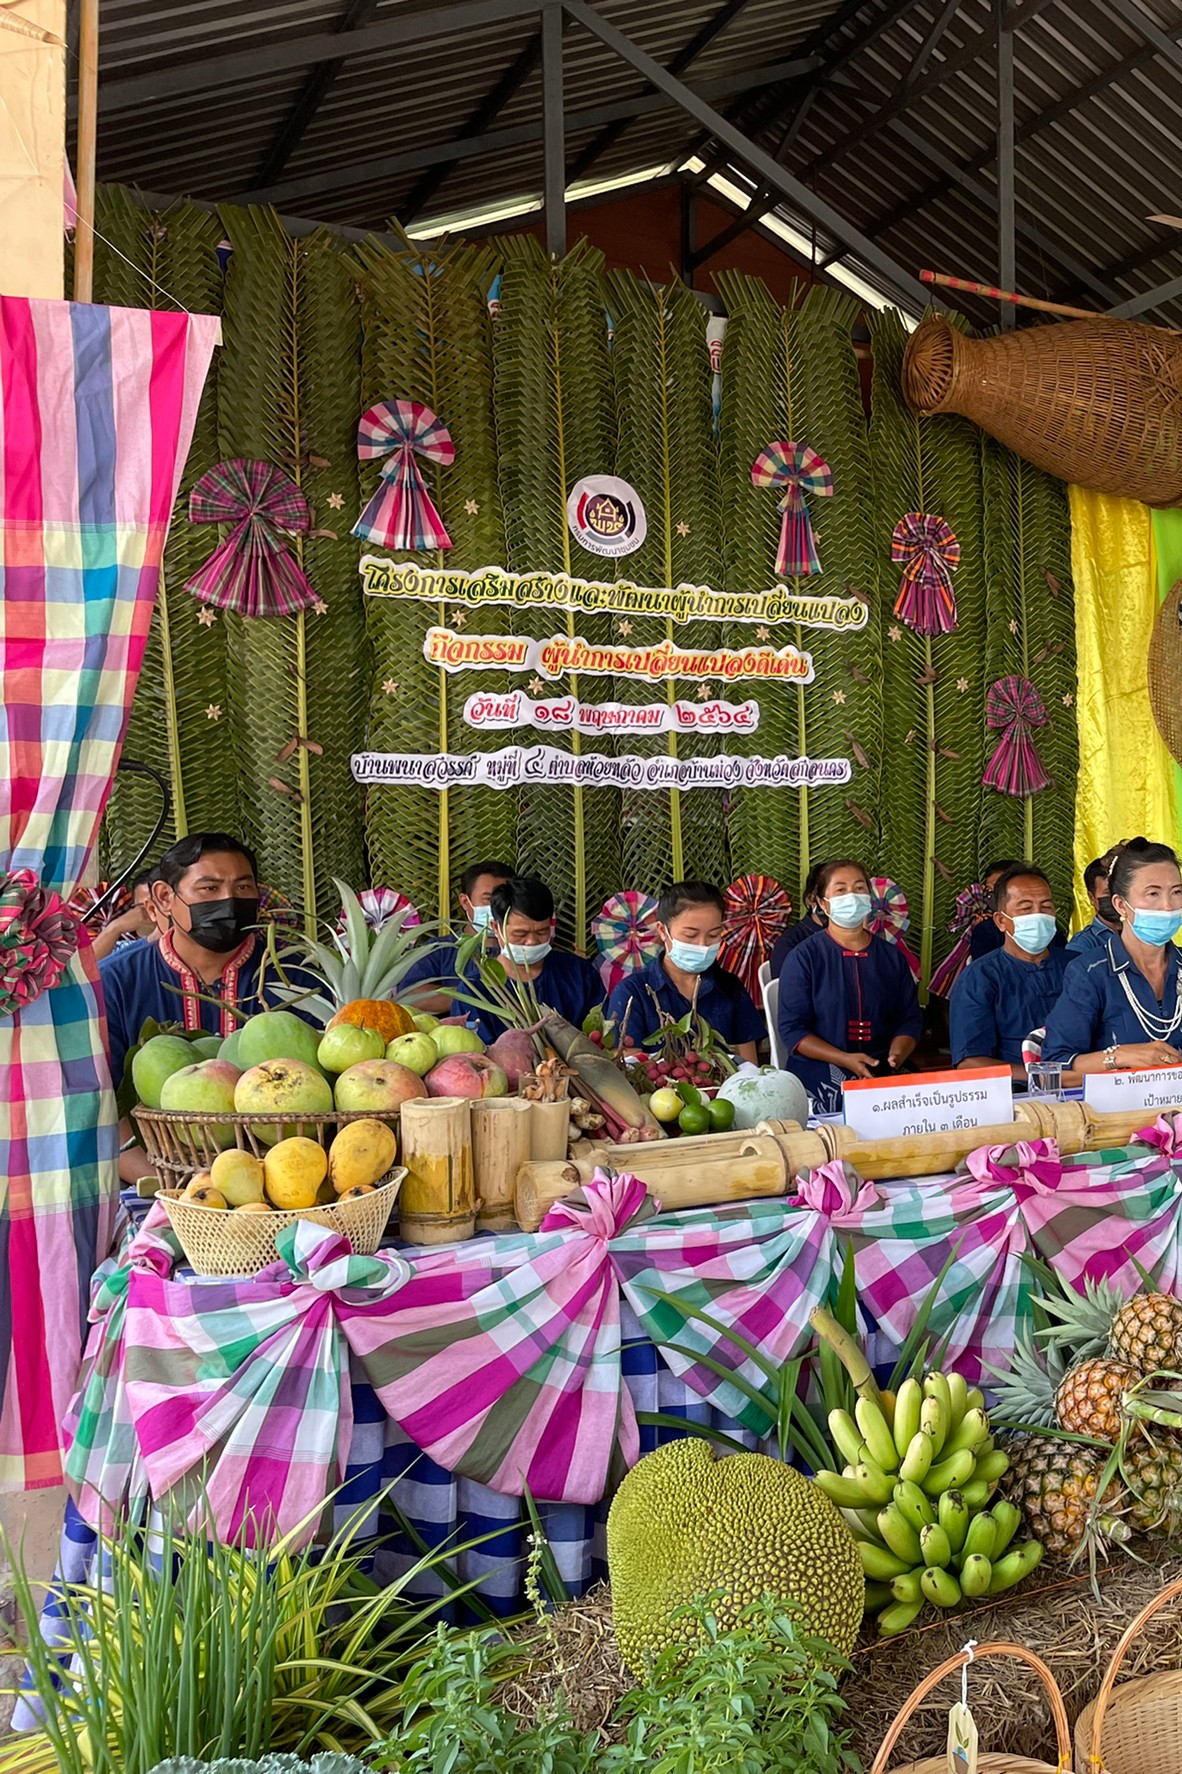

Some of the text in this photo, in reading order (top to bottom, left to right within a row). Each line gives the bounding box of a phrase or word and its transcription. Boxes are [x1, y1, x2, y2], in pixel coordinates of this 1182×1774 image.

[572, 525, 640, 555] กรมการพัฒนาชุมชน
[365, 562, 865, 625] โครงการเสริมสร้างและพัฒนาผู้นำการเปลี่ยนแปลง
[431, 633, 808, 676] กิจกรรม ผู้นำการเปลี่ยนแปลงดีเด่น
[470, 694, 751, 727] วันที่ ๑๘ พฤษภาคม ๒๕๖๔
[354, 755, 478, 779] บ้านพนาสวรรค์
[486, 749, 519, 781] หมู่ที่
[647, 759, 741, 783] อำเภอบ้านม่วง
[746, 757, 847, 781] จังหวัดสกลนคร
[1114, 1075, 1124, 1086] ๒.
[1143, 1093, 1182, 1107] เป้าหมาย
[902, 1114, 978, 1136] ภายใน ๓ เดือน
